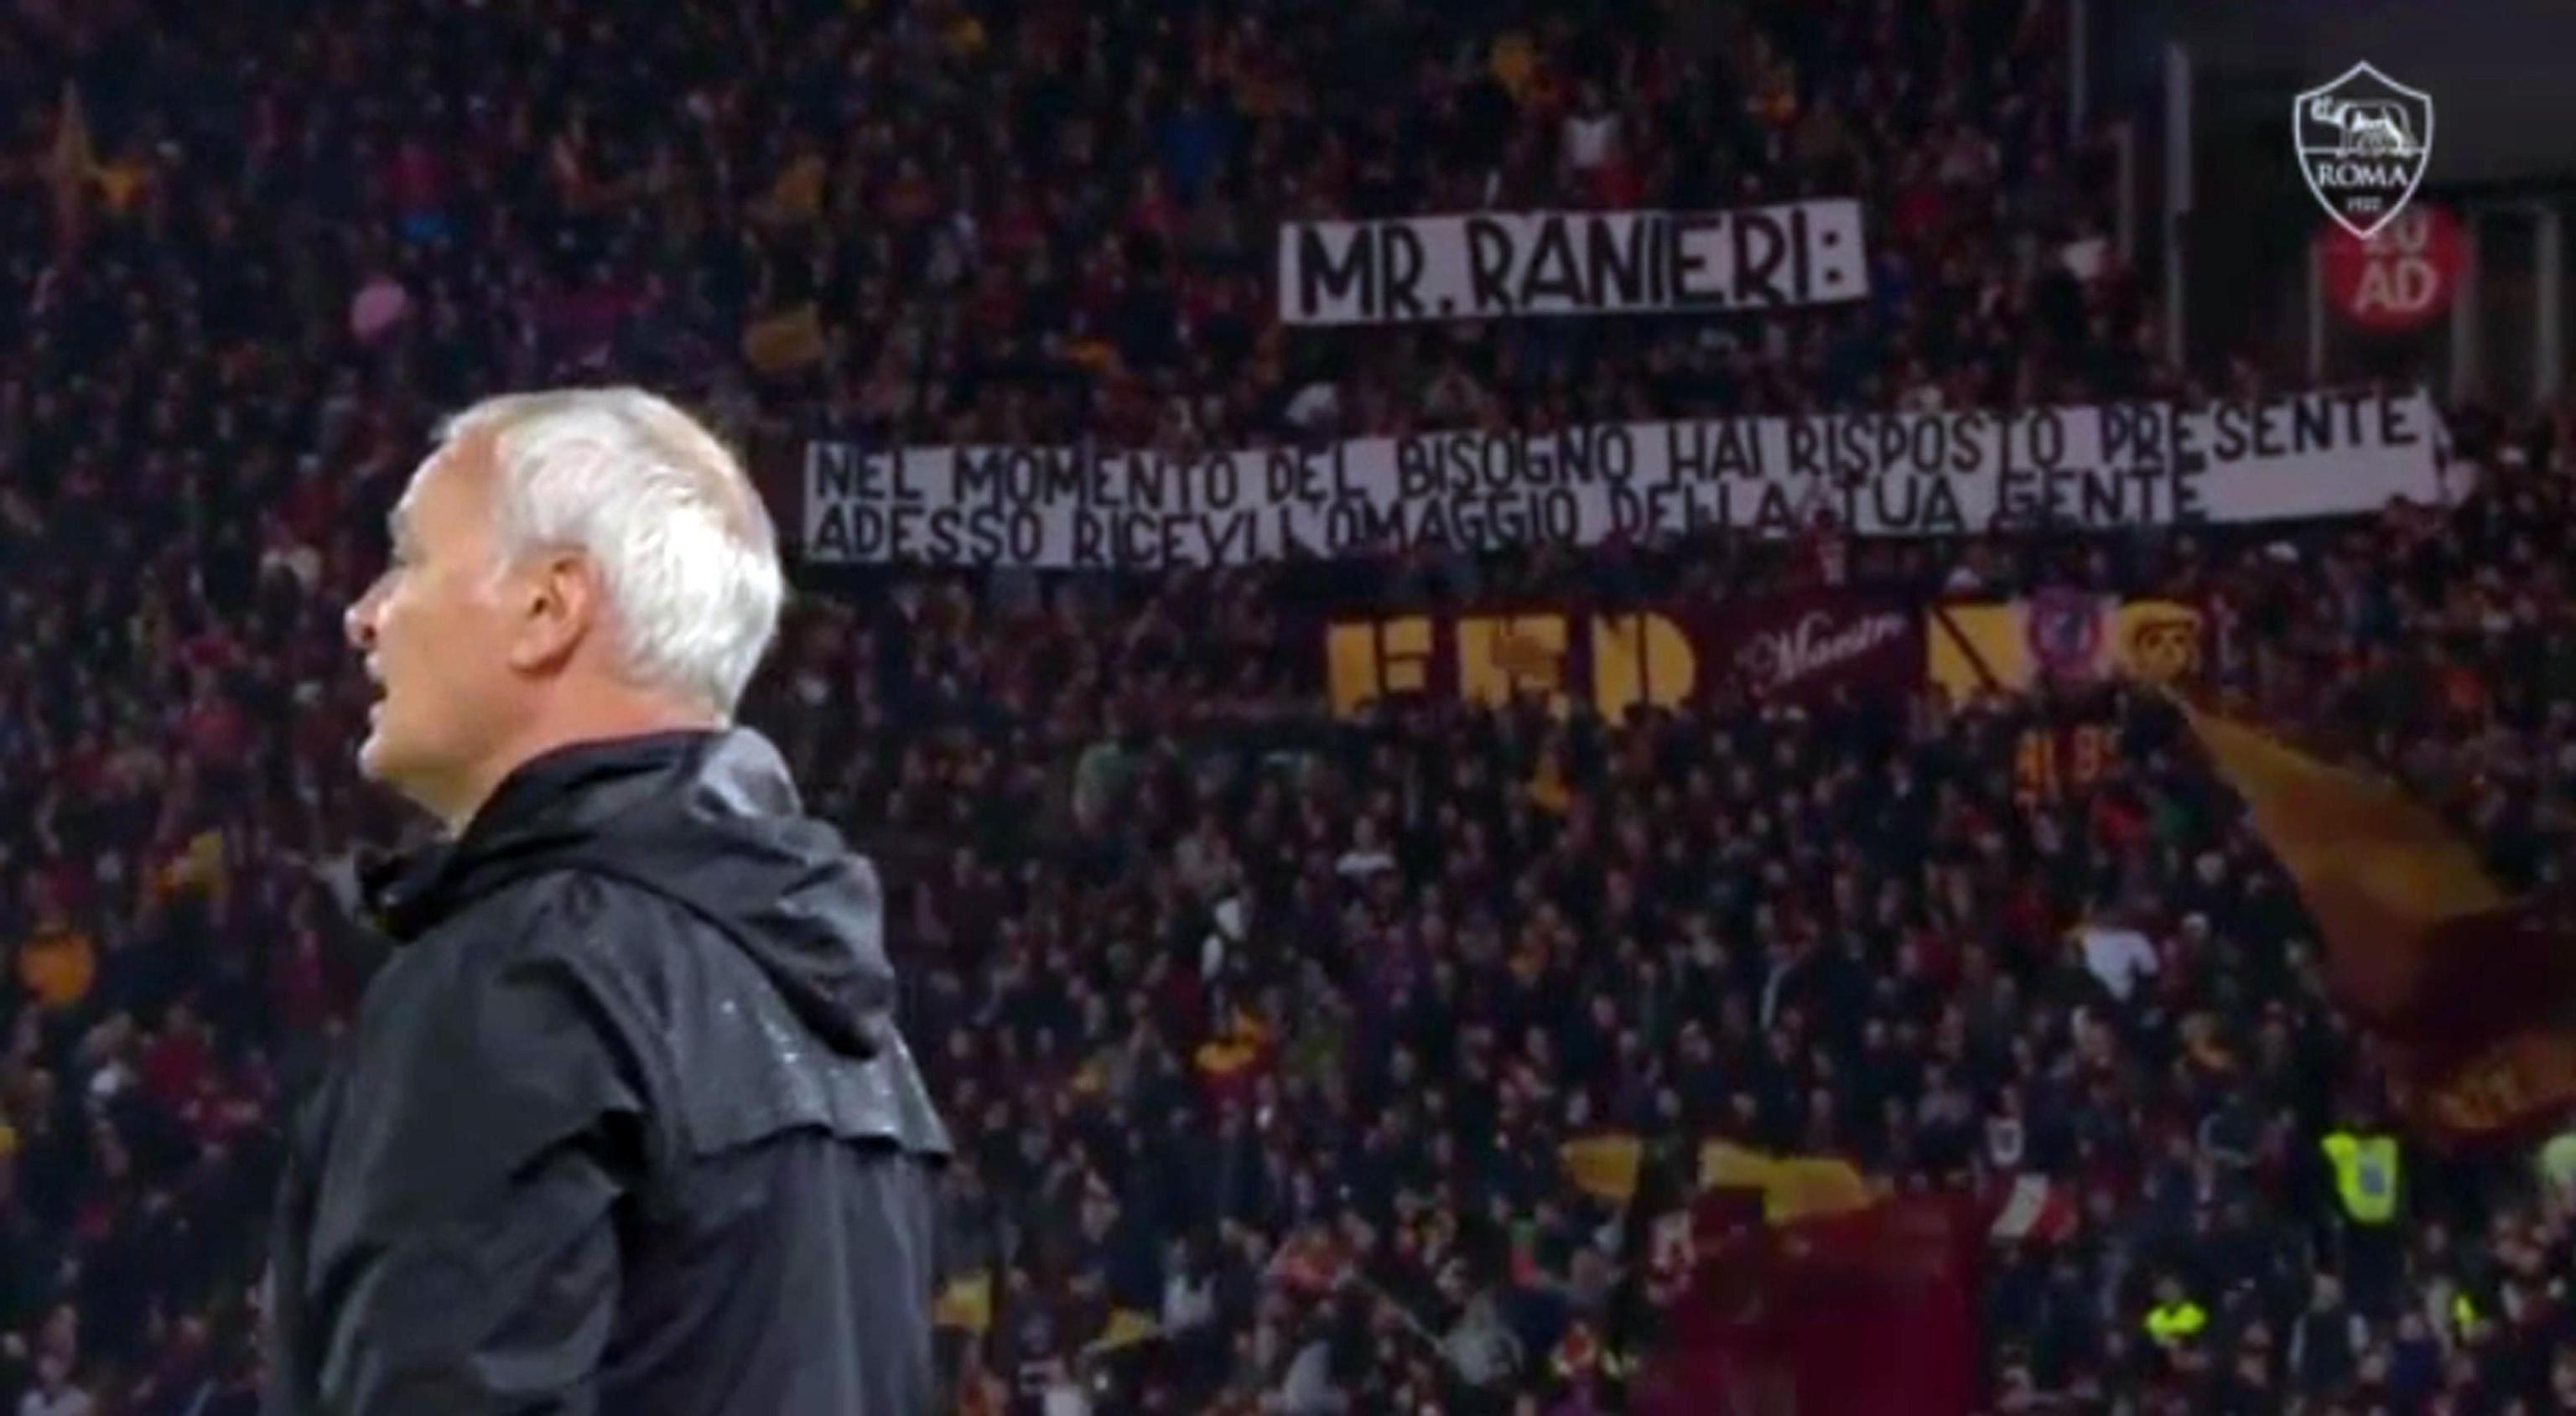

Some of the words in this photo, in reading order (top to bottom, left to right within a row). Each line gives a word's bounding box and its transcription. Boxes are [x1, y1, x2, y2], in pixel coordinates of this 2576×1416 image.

[2353, 257, 2438, 314] AD
[816, 449, 921, 501] NEL
[954, 448, 1239, 509] MOMENTO
[1266, 444, 1366, 503] DEL
[1397, 426, 1633, 500] BISOGNO
[1668, 421, 1763, 481] HAI
[1786, 411, 2064, 478] RISPOSTO
[2100, 389, 2418, 475] PRESENTE
[815, 507, 1041, 564] ADESSO
[1074, 509, 1257, 566] RICEVI
[1996, 467, 2208, 526] GENTE
